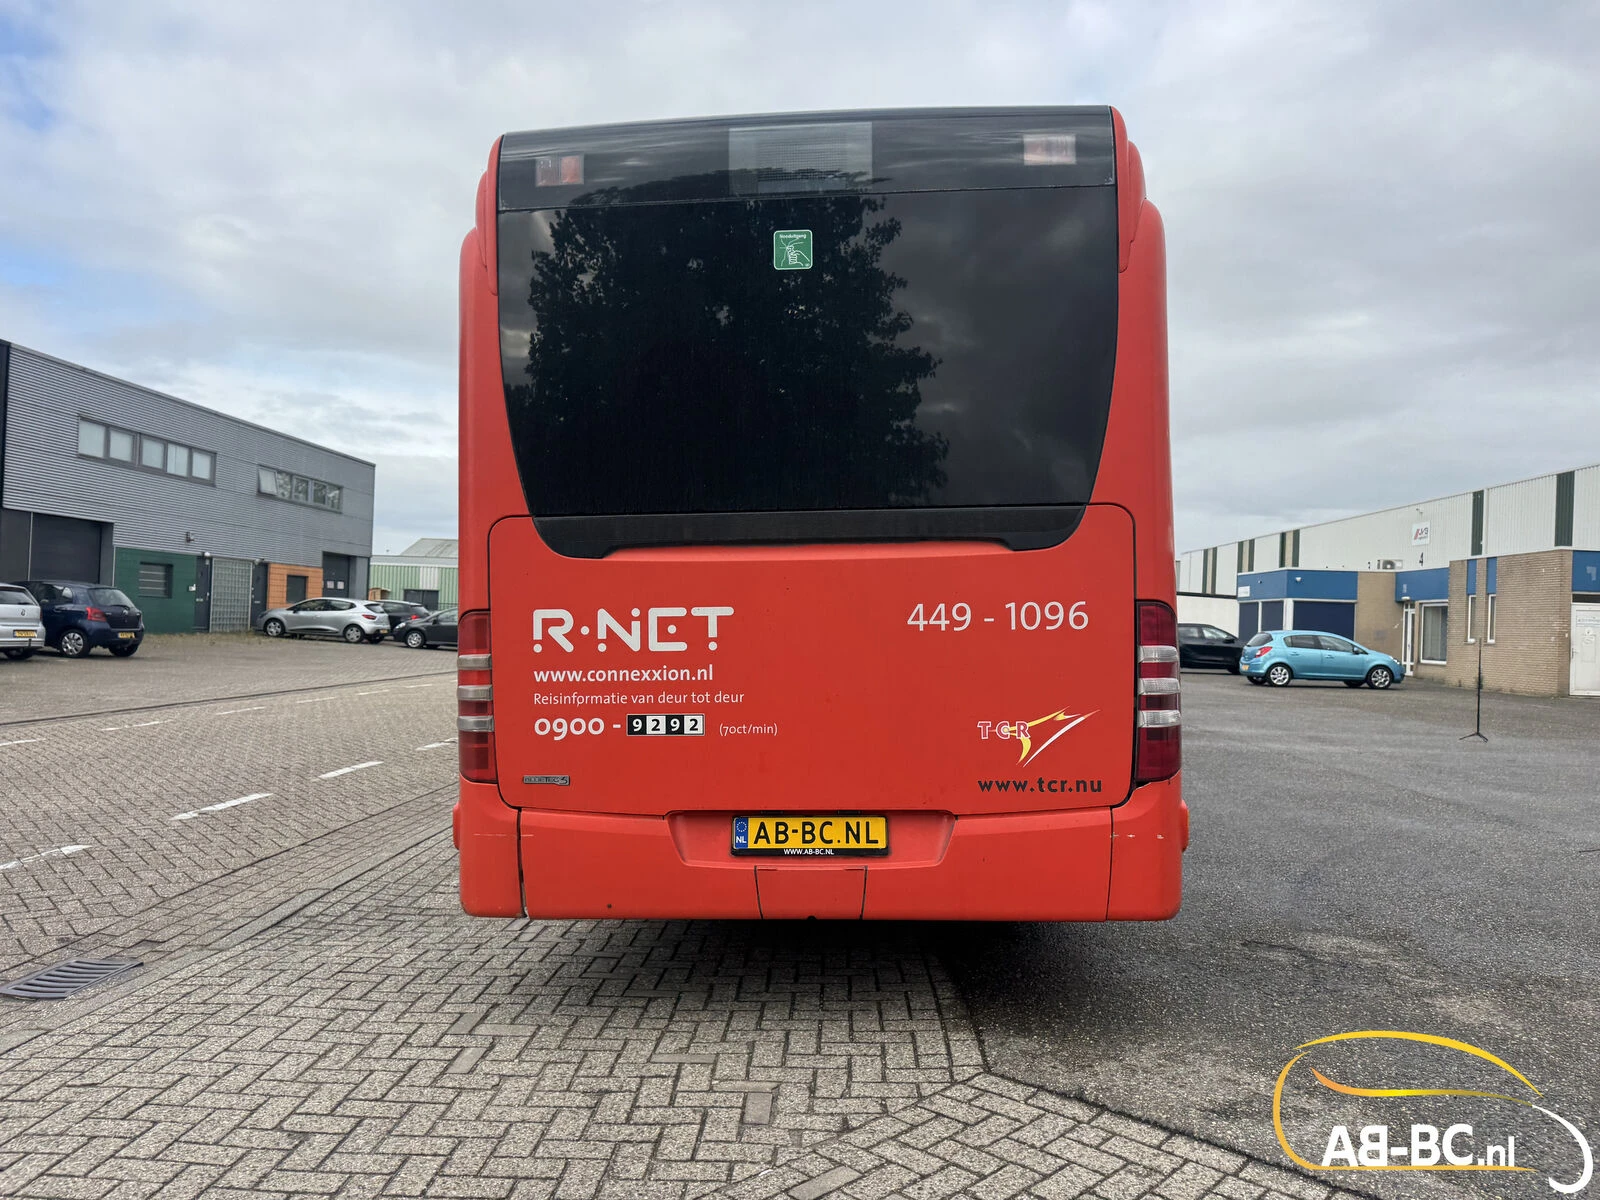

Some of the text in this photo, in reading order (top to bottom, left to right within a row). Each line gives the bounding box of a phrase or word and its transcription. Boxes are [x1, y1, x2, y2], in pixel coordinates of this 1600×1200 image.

[907, 602, 972, 631] 449
[1005, 601, 1089, 630] 1096
[533, 664, 714, 683] www.connexxion.nl
[533, 691, 745, 707] Reisinformatie van deur tot deur
[533, 717, 605, 741] 0900
[631, 717, 700, 734] 9292
[719, 723, 779, 736] (70ct/min)
[977, 720, 1031, 739] TCR
[977, 776, 1103, 793] www.tcr.nu
[735, 835, 747, 844] NL
[753, 821, 879, 845] AB-BC.NL
[783, 848, 835, 856] WWW.AB-BC.NL
